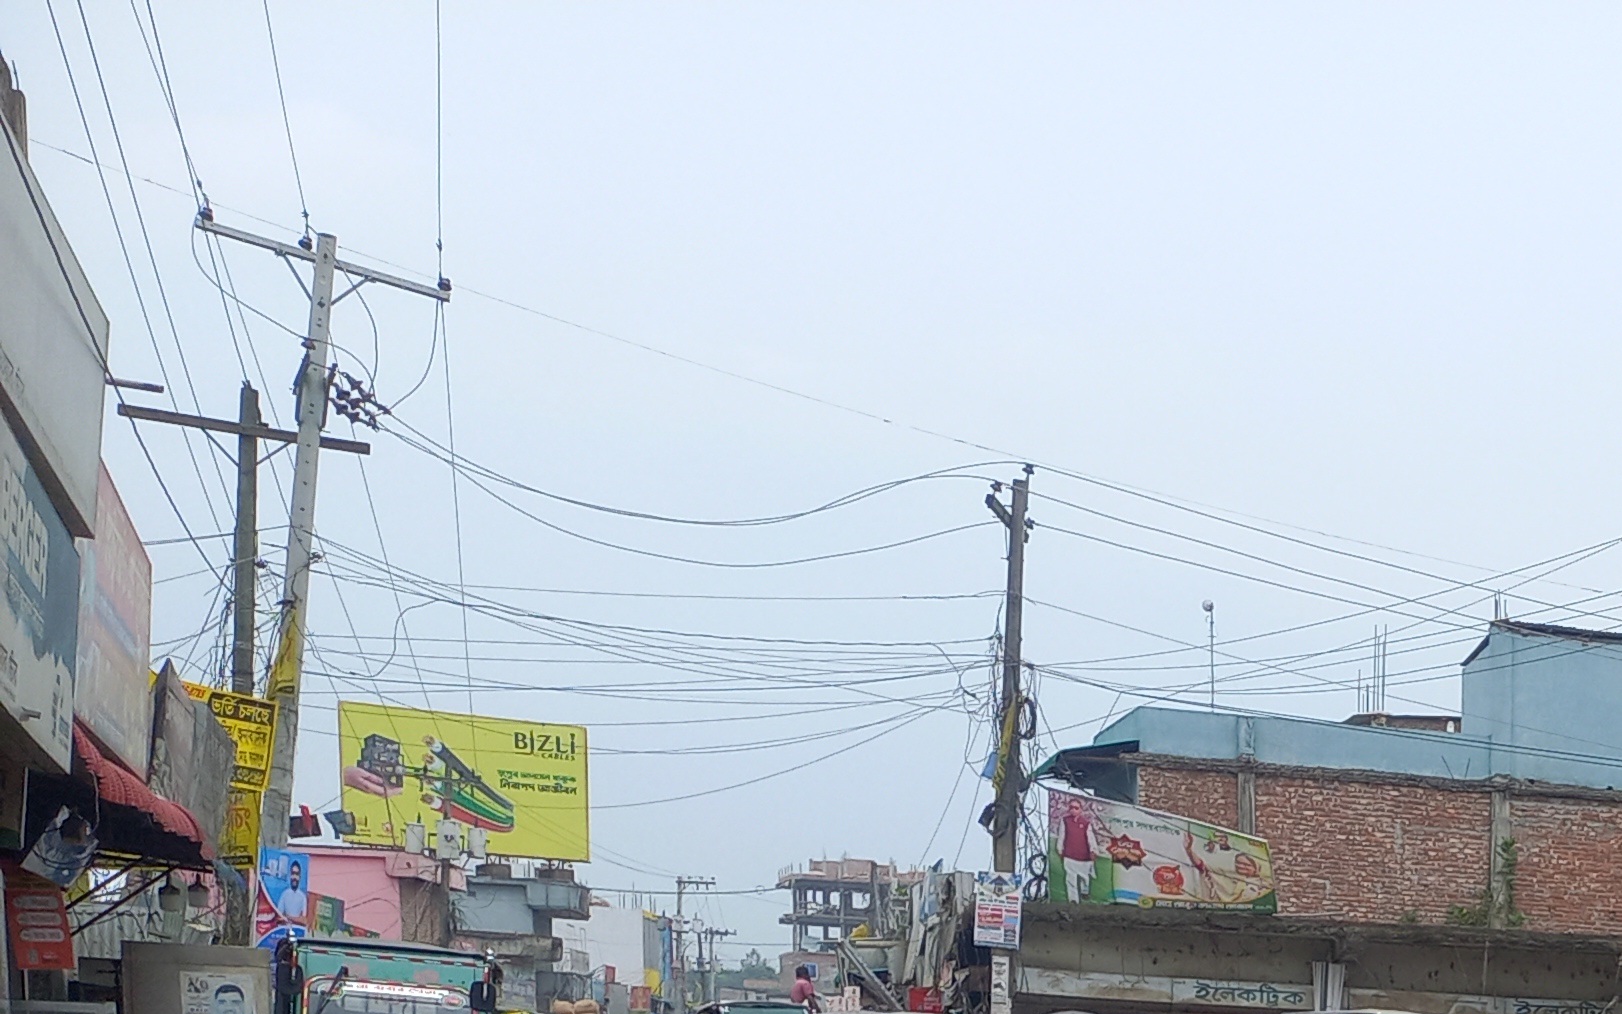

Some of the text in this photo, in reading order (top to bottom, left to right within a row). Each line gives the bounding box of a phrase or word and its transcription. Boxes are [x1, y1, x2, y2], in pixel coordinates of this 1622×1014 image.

[211, 696, 272, 725] ভর্তি চলছে
[514, 729, 576, 755] BIZLI
[541, 752, 576, 762] CABLES
[1193, 980, 1307, 1009] ইলেকট্রিক
